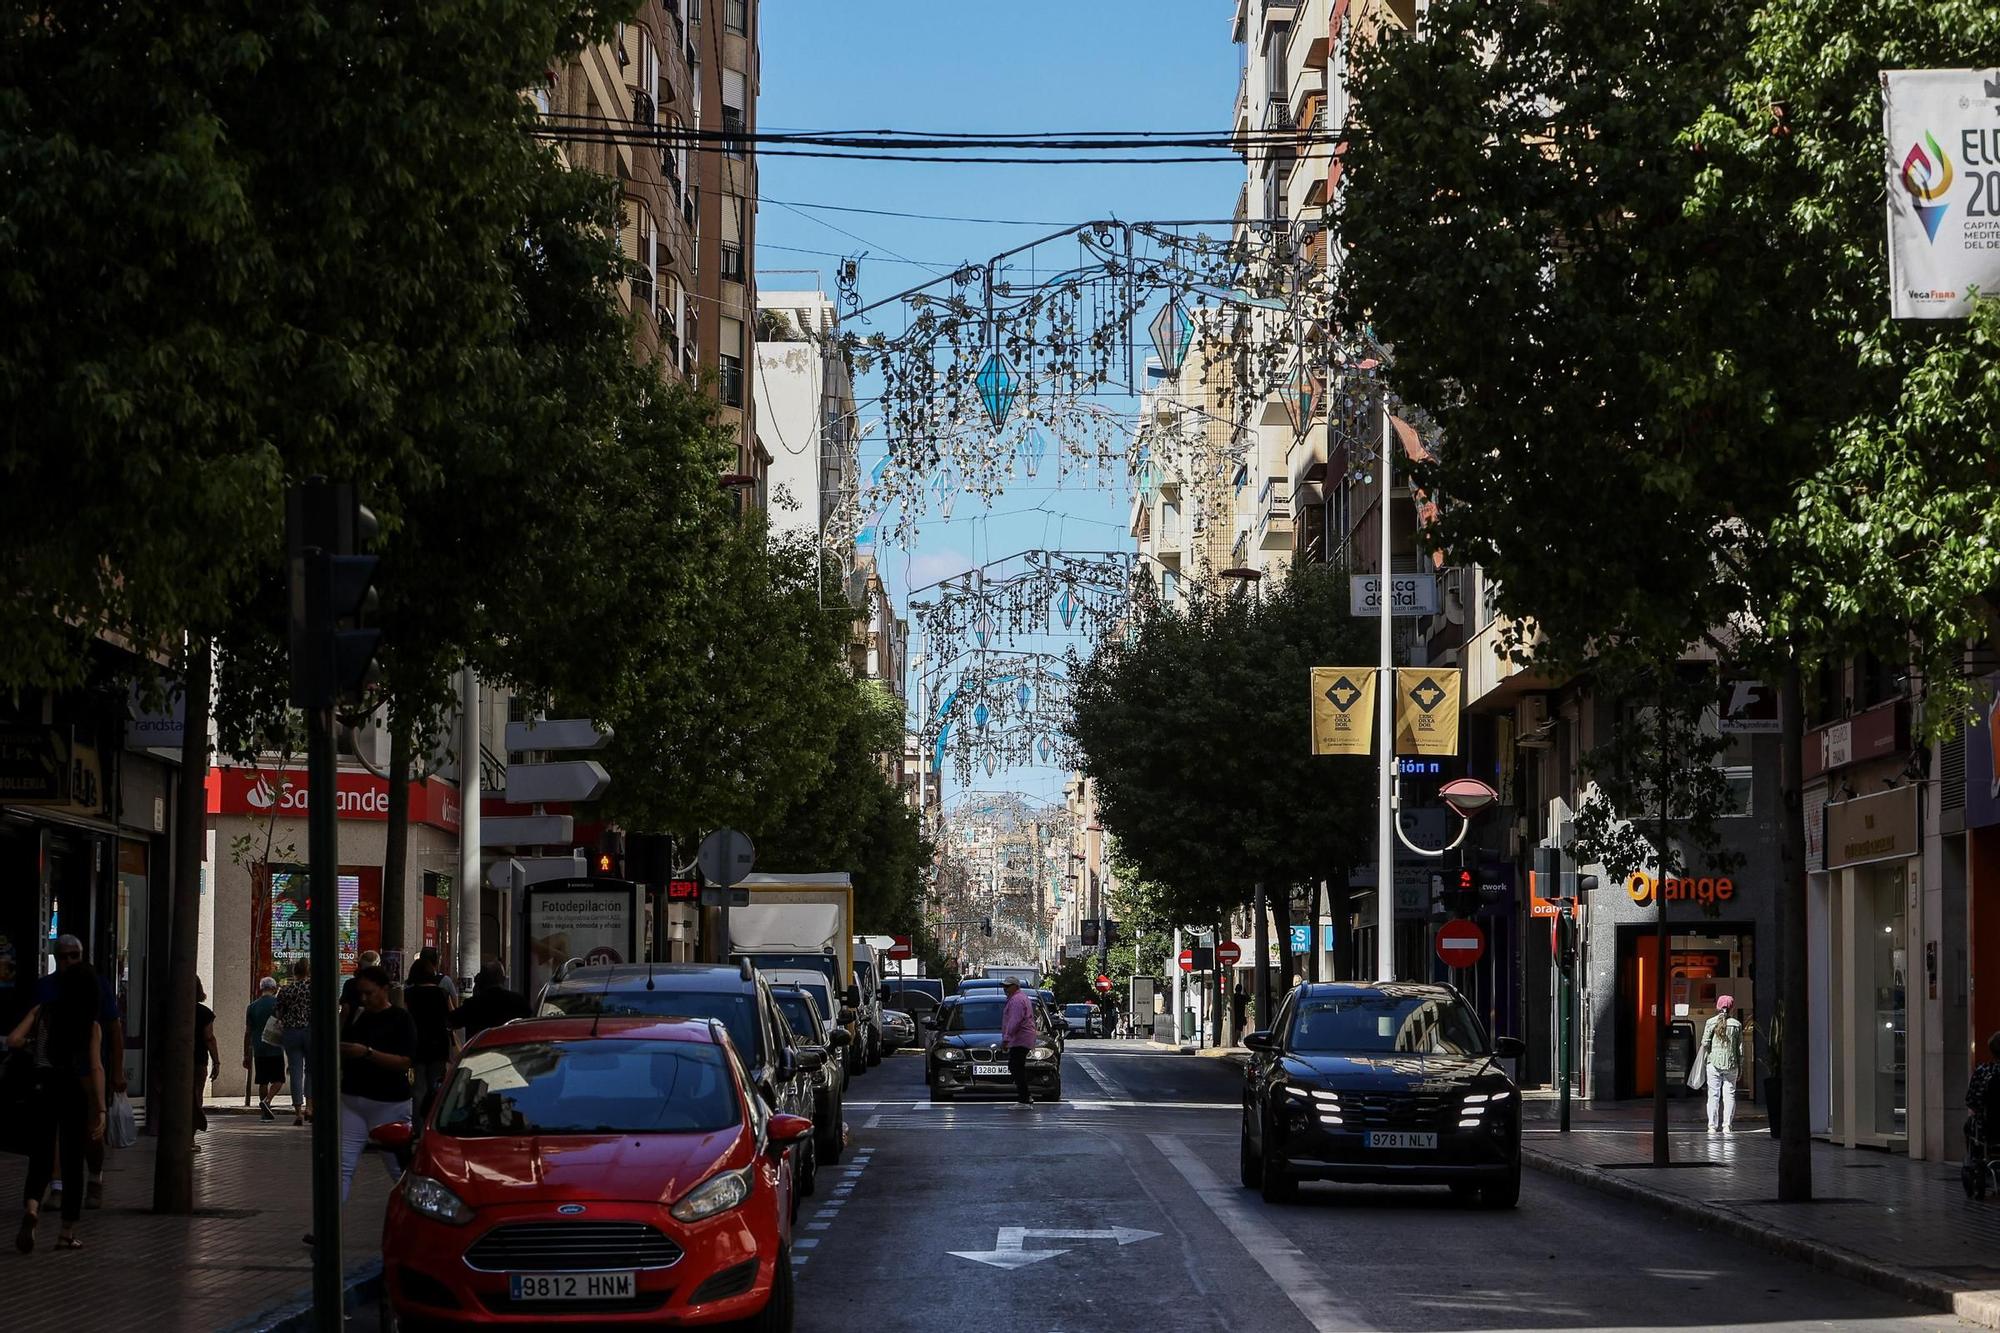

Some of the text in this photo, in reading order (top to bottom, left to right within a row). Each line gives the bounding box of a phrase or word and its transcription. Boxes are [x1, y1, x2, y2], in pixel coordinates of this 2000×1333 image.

[1964, 241, 1984, 250] DEL
[136, 719, 185, 731] randsta
[280, 783, 390, 813] Saande
[1627, 872, 1734, 905] Orange
[542, 900, 622, 913] Fotodepilación
[1534, 905, 1562, 914] oran
[978, 1066, 1010, 1074] 3280 MG
[1373, 1134, 1432, 1147] 9781 NLY
[524, 1277, 576, 1297] 9812
[588, 1276, 629, 1296] HNM
